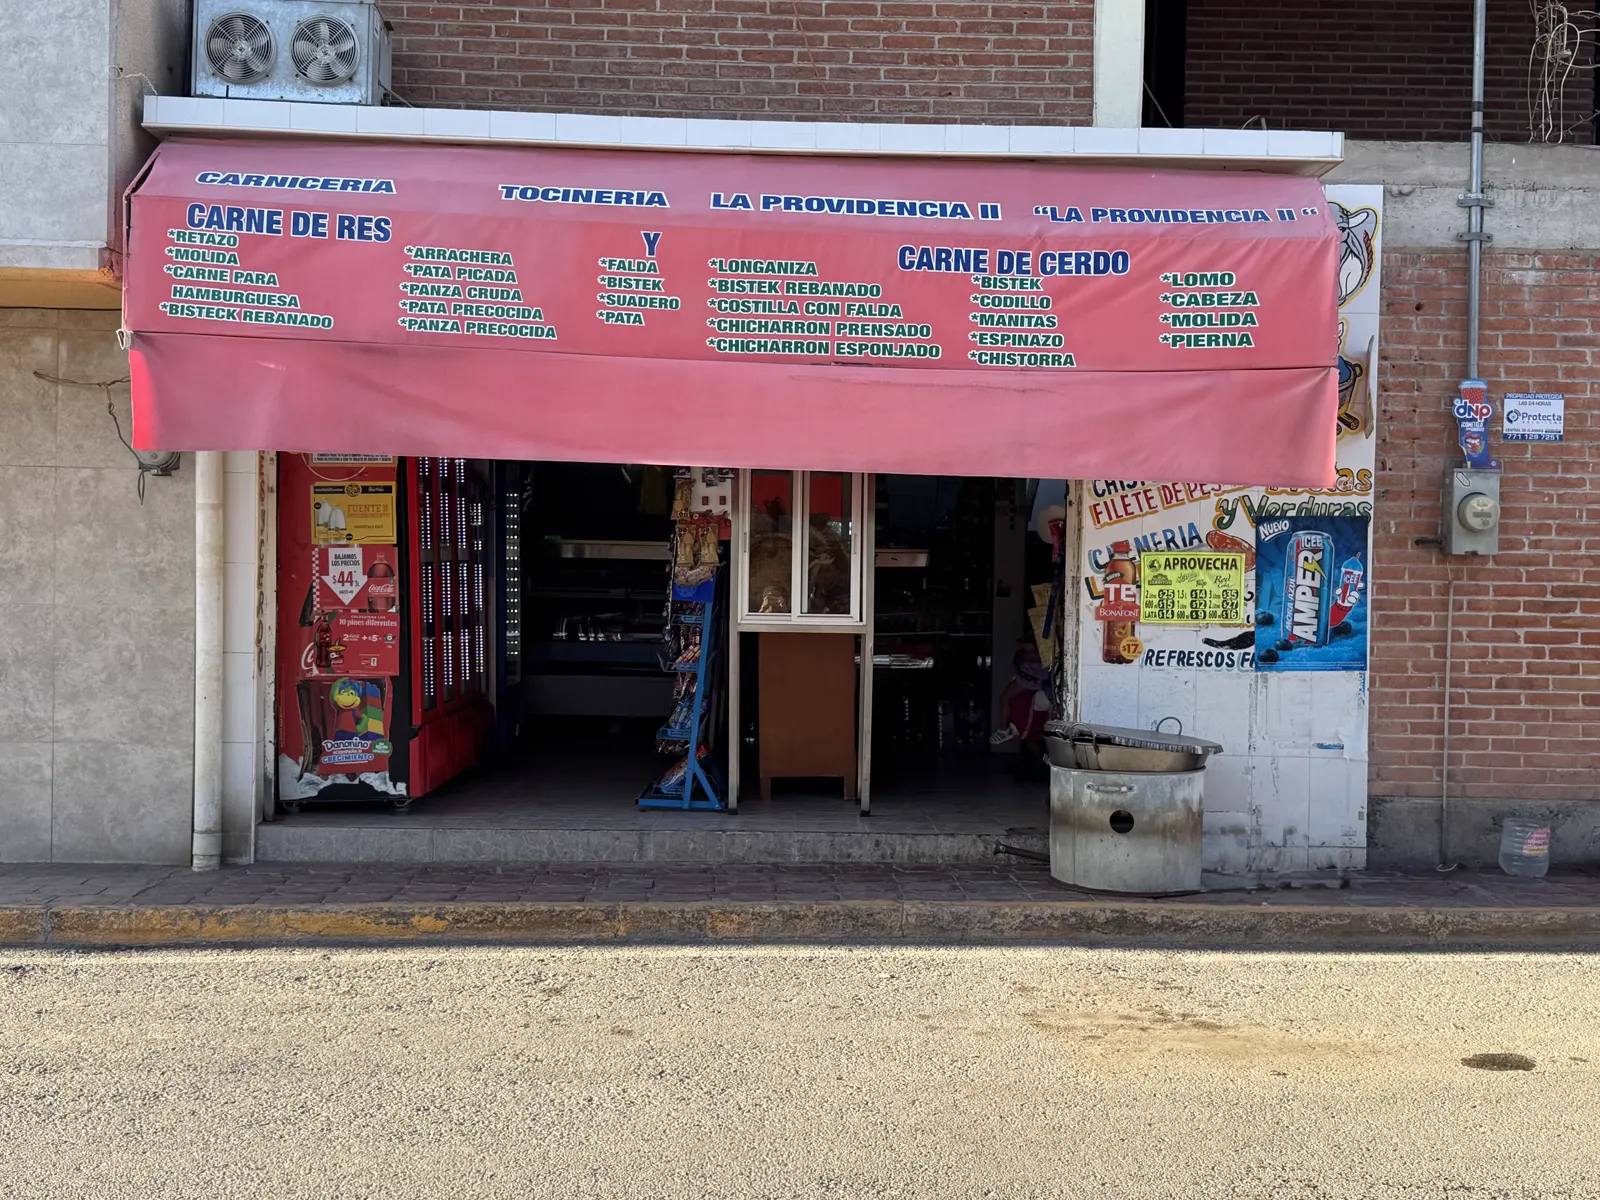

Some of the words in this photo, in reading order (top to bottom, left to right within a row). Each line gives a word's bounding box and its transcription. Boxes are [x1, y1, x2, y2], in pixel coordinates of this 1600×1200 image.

[196, 172, 396, 194] CARNICERIA
[499, 183, 670, 209] TOCINERIA
[710, 192, 752, 211] LA
[760, 195, 974, 220] PROVIDENCIA
[979, 204, 1002, 220] II
[186, 203, 282, 233] CARNE
[292, 211, 329, 239] DE
[336, 213, 392, 243] RES
[1091, 208, 1270, 223] PROVIDENCIA
[1277, 208, 1297, 221] II
[642, 232, 662, 256] Y
[898, 245, 989, 274] CARNE
[997, 250, 1033, 276] DE
[1039, 250, 1130, 276] CERDO
[233, 270, 279, 287] PARA
[456, 266, 517, 284] PICADA
[172, 285, 300, 308] HAMBURGUESA
[466, 286, 523, 302] CRUDA
[784, 281, 882, 298] REBANADO
[242, 308, 334, 330] REBANADO
[452, 302, 544, 322] PRECOCIDA
[804, 302, 841, 316] CON
[845, 302, 903, 319] FALDA
[465, 321, 556, 339] PRECOCIDA
[835, 322, 931, 339] PRENSADO
[834, 341, 942, 359] ESPONJADO
[1522, 412, 1562, 421] Protecta
[1093, 488, 1157, 525] FILETE
[1162, 482, 1184, 504] DE
[1259, 520, 1290, 540] NUEVO
[1092, 522, 1203, 571] CMERIA
[1301, 536, 1323, 549] ICEE
[1163, 557, 1238, 570] APROVECHA
[1159, 590, 1174, 599] $25
[1192, 590, 1206, 598] $14
[1223, 590, 1238, 599] $35
[1293, 550, 1323, 643] AMPER
[1100, 608, 1139, 617] BONAFONT
[1159, 600, 1174, 609] $15
[1192, 600, 1206, 609] $12
[1223, 600, 1238, 609] $27
[1159, 610, 1174, 618] $14
[1223, 610, 1238, 619] $16
[365, 619, 397, 627] diferentes
[1144, 648, 1236, 668] REFRESCOS
[322, 737, 370, 752] Danonino
[322, 753, 374, 763] CRECIMIENTO
